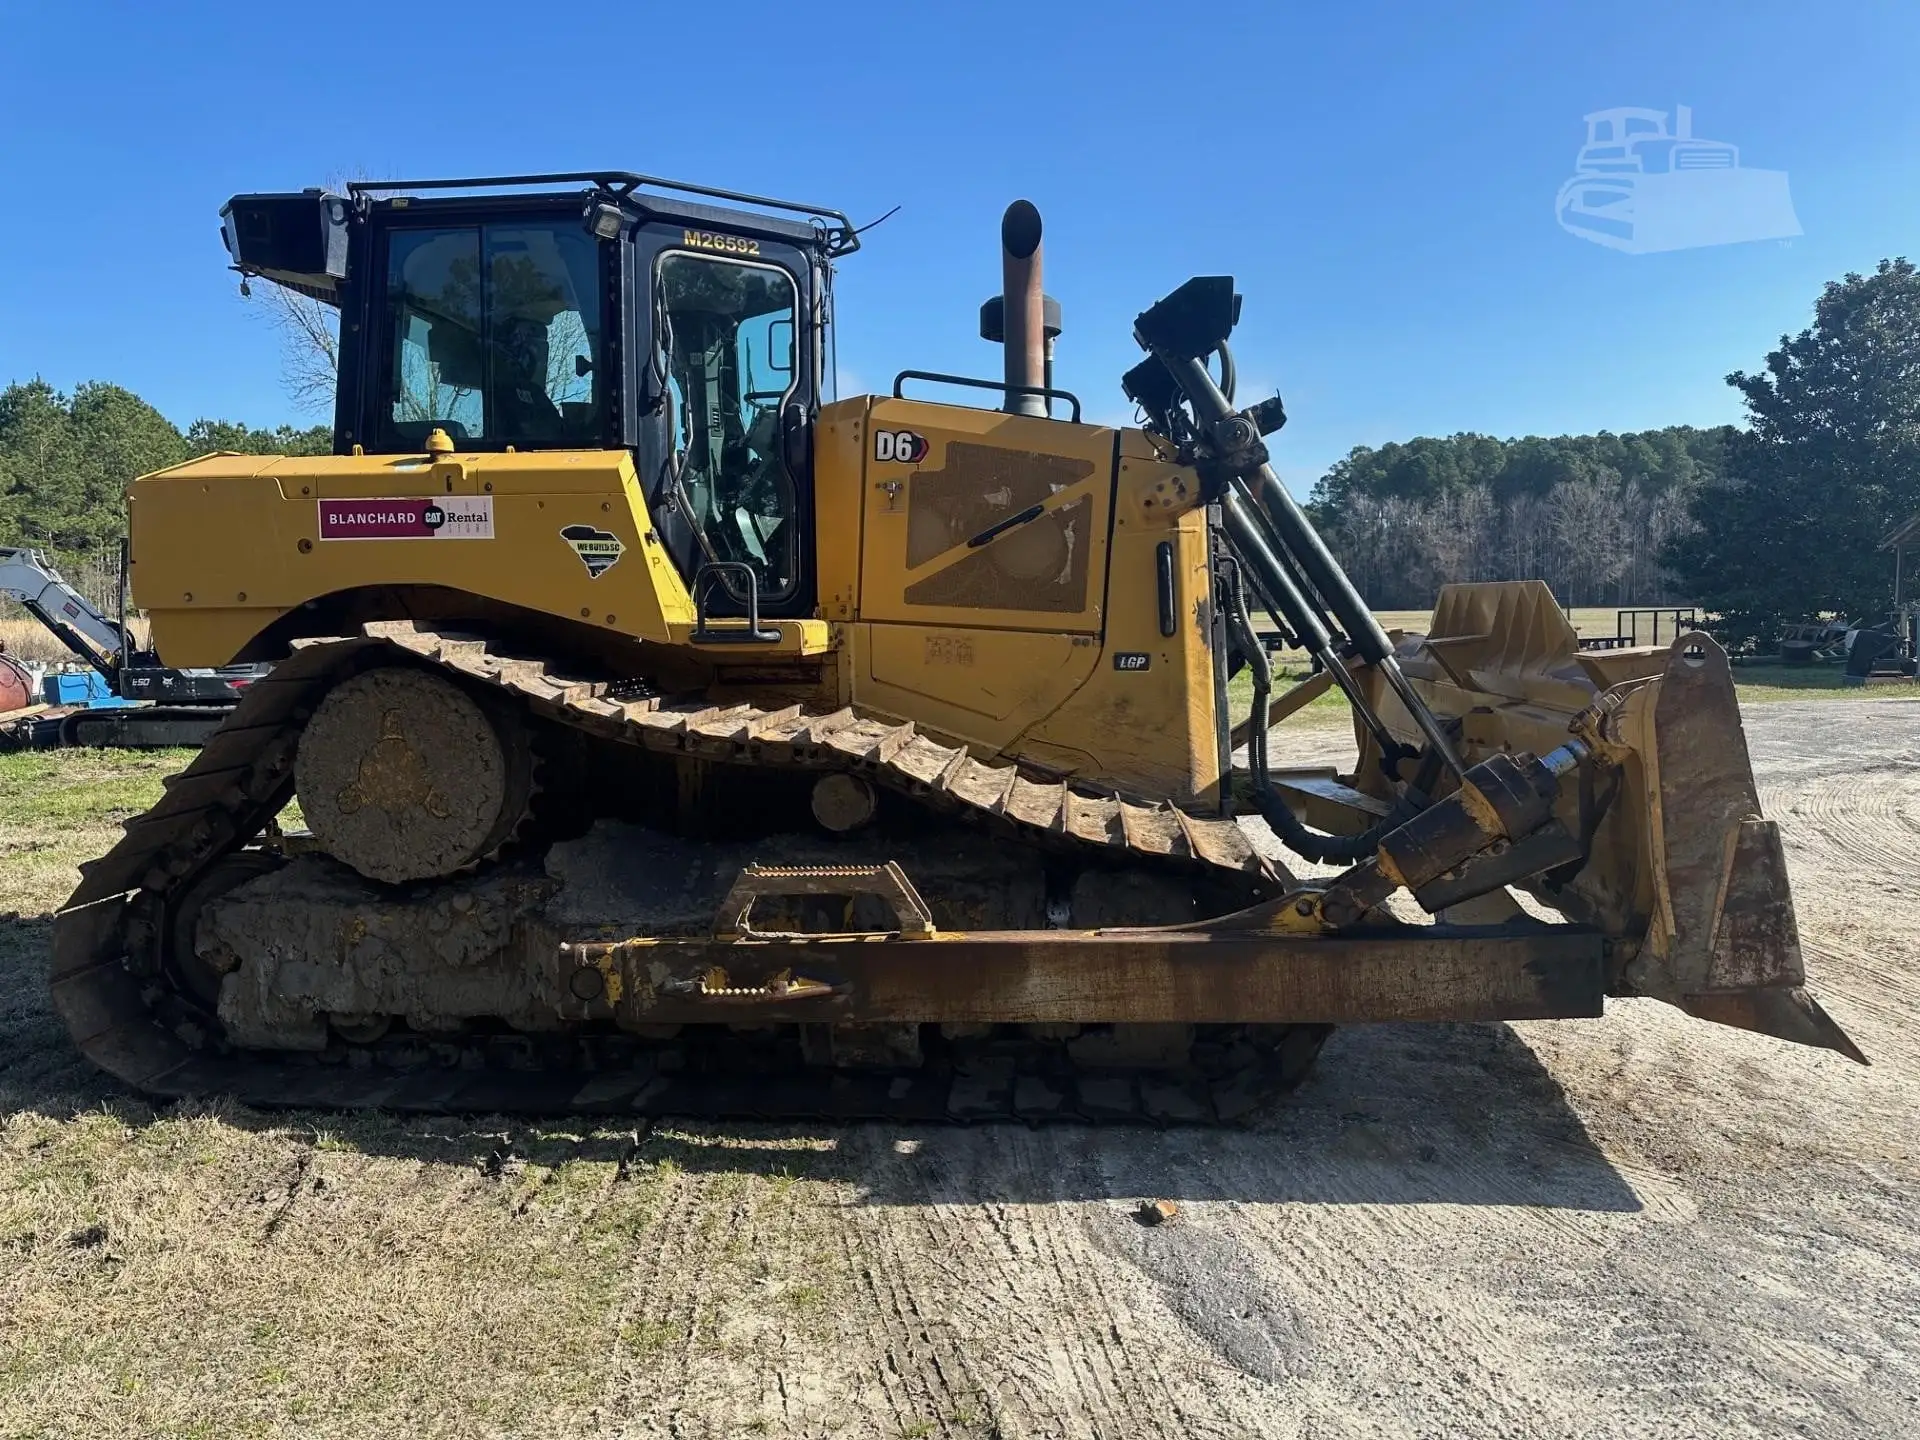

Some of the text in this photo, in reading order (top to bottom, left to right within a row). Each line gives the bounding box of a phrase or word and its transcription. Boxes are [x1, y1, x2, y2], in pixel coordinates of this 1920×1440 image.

[684, 230, 760, 255] M26592
[876, 431, 912, 461] D6
[329, 511, 488, 525] BLANCHARD CAT Rental
[1120, 656, 1146, 668] LGP
